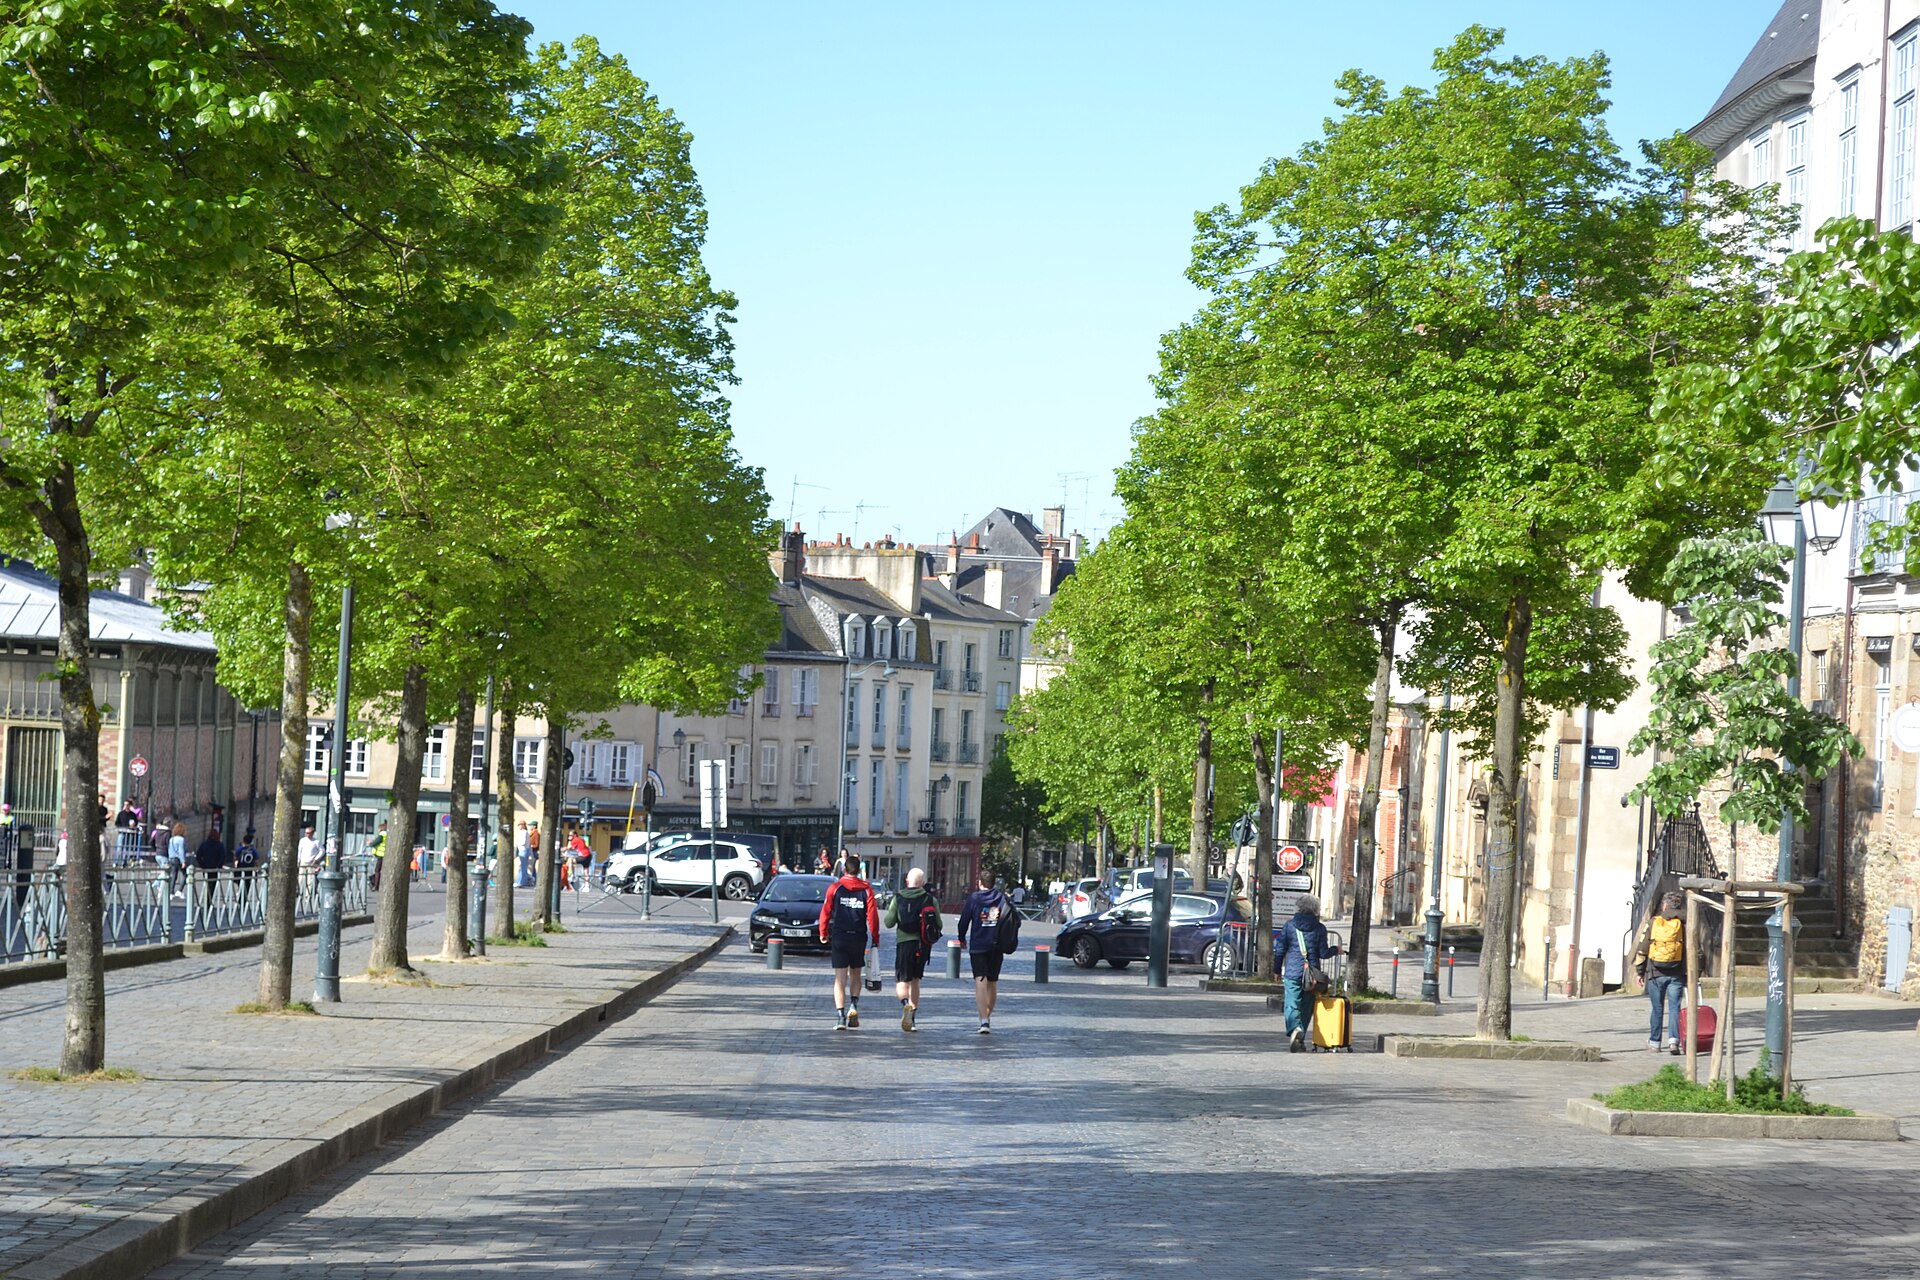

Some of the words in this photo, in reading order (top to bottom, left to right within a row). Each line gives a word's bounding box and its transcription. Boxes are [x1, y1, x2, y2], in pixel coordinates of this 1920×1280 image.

[668, 817, 689, 825] AGENCE
[732, 818, 744, 826] Vente
[787, 817, 807, 825] AGENCE
[808, 817, 818, 825] DES
[819, 817, 833, 825] LICES
[1210, 846, 1219, 859] 3
[240, 853, 254, 863] 10
[1280, 852, 1300, 863] STOP
